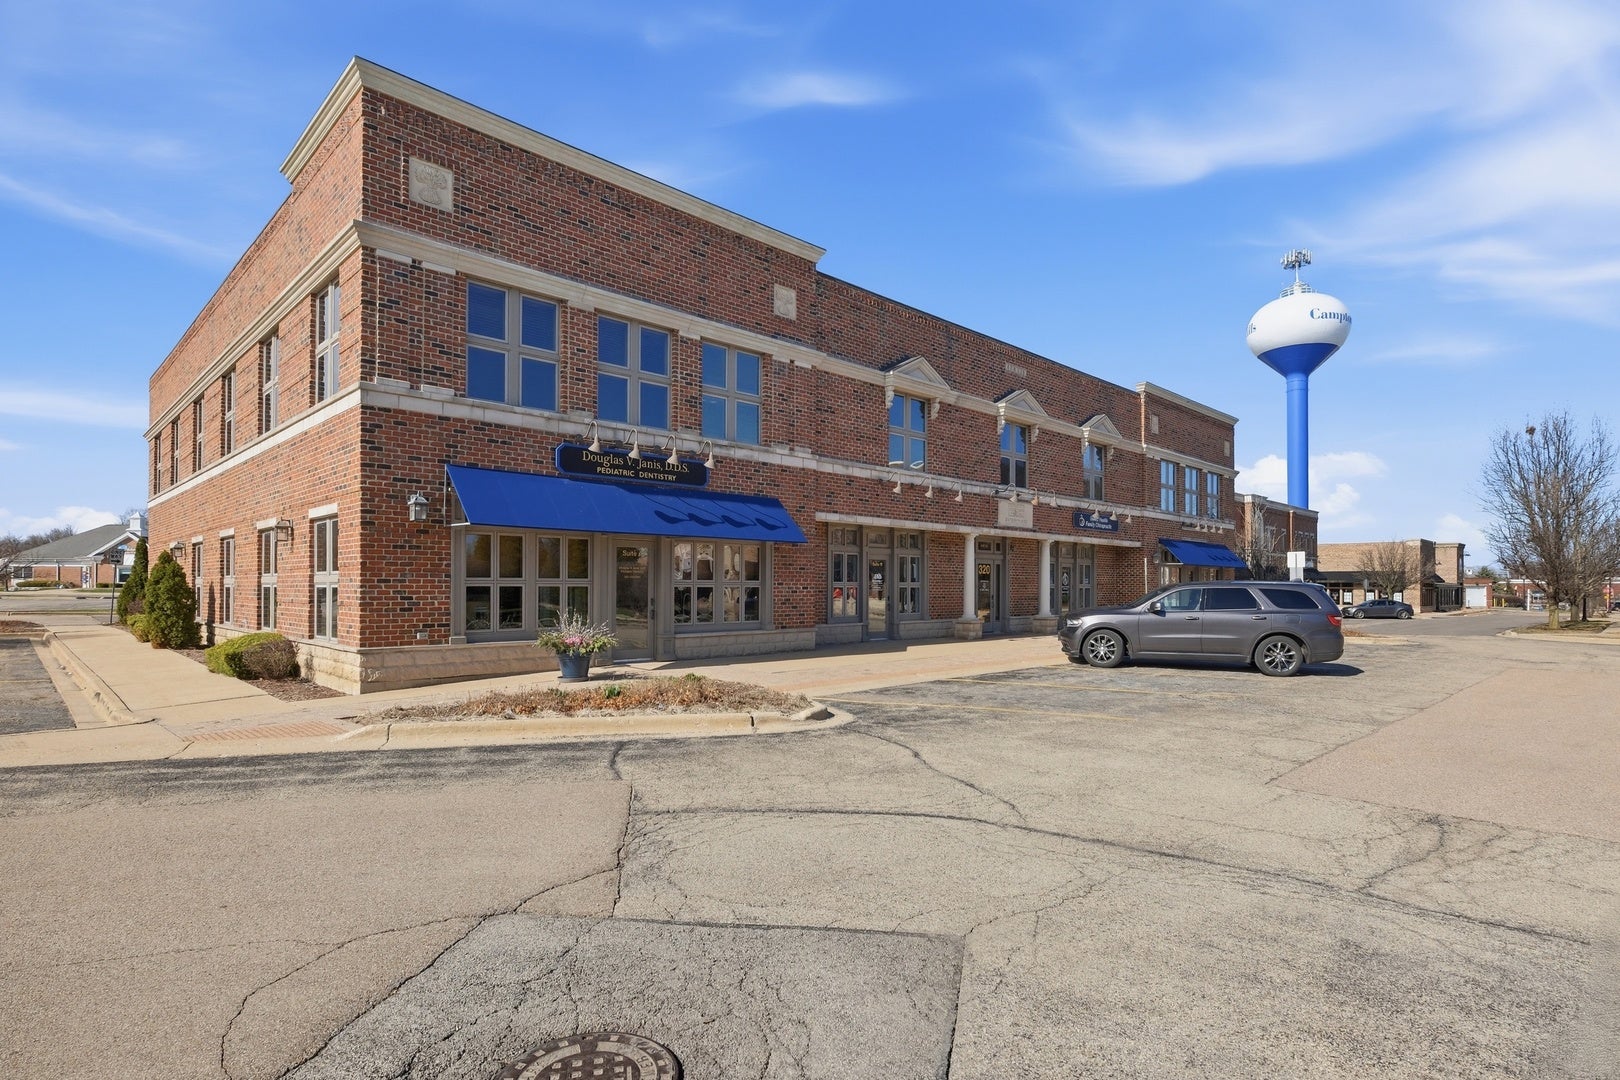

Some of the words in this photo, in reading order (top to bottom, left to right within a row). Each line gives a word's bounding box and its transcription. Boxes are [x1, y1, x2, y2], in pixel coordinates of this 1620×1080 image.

[582, 450, 623, 467] Douglas
[626, 456, 635, 467] V.
[637, 459, 663, 472] Janis,
[596, 467, 635, 477] PEDIATRIC
[639, 472, 677, 481] DENTISTRY
[978, 564, 991, 575] 320
